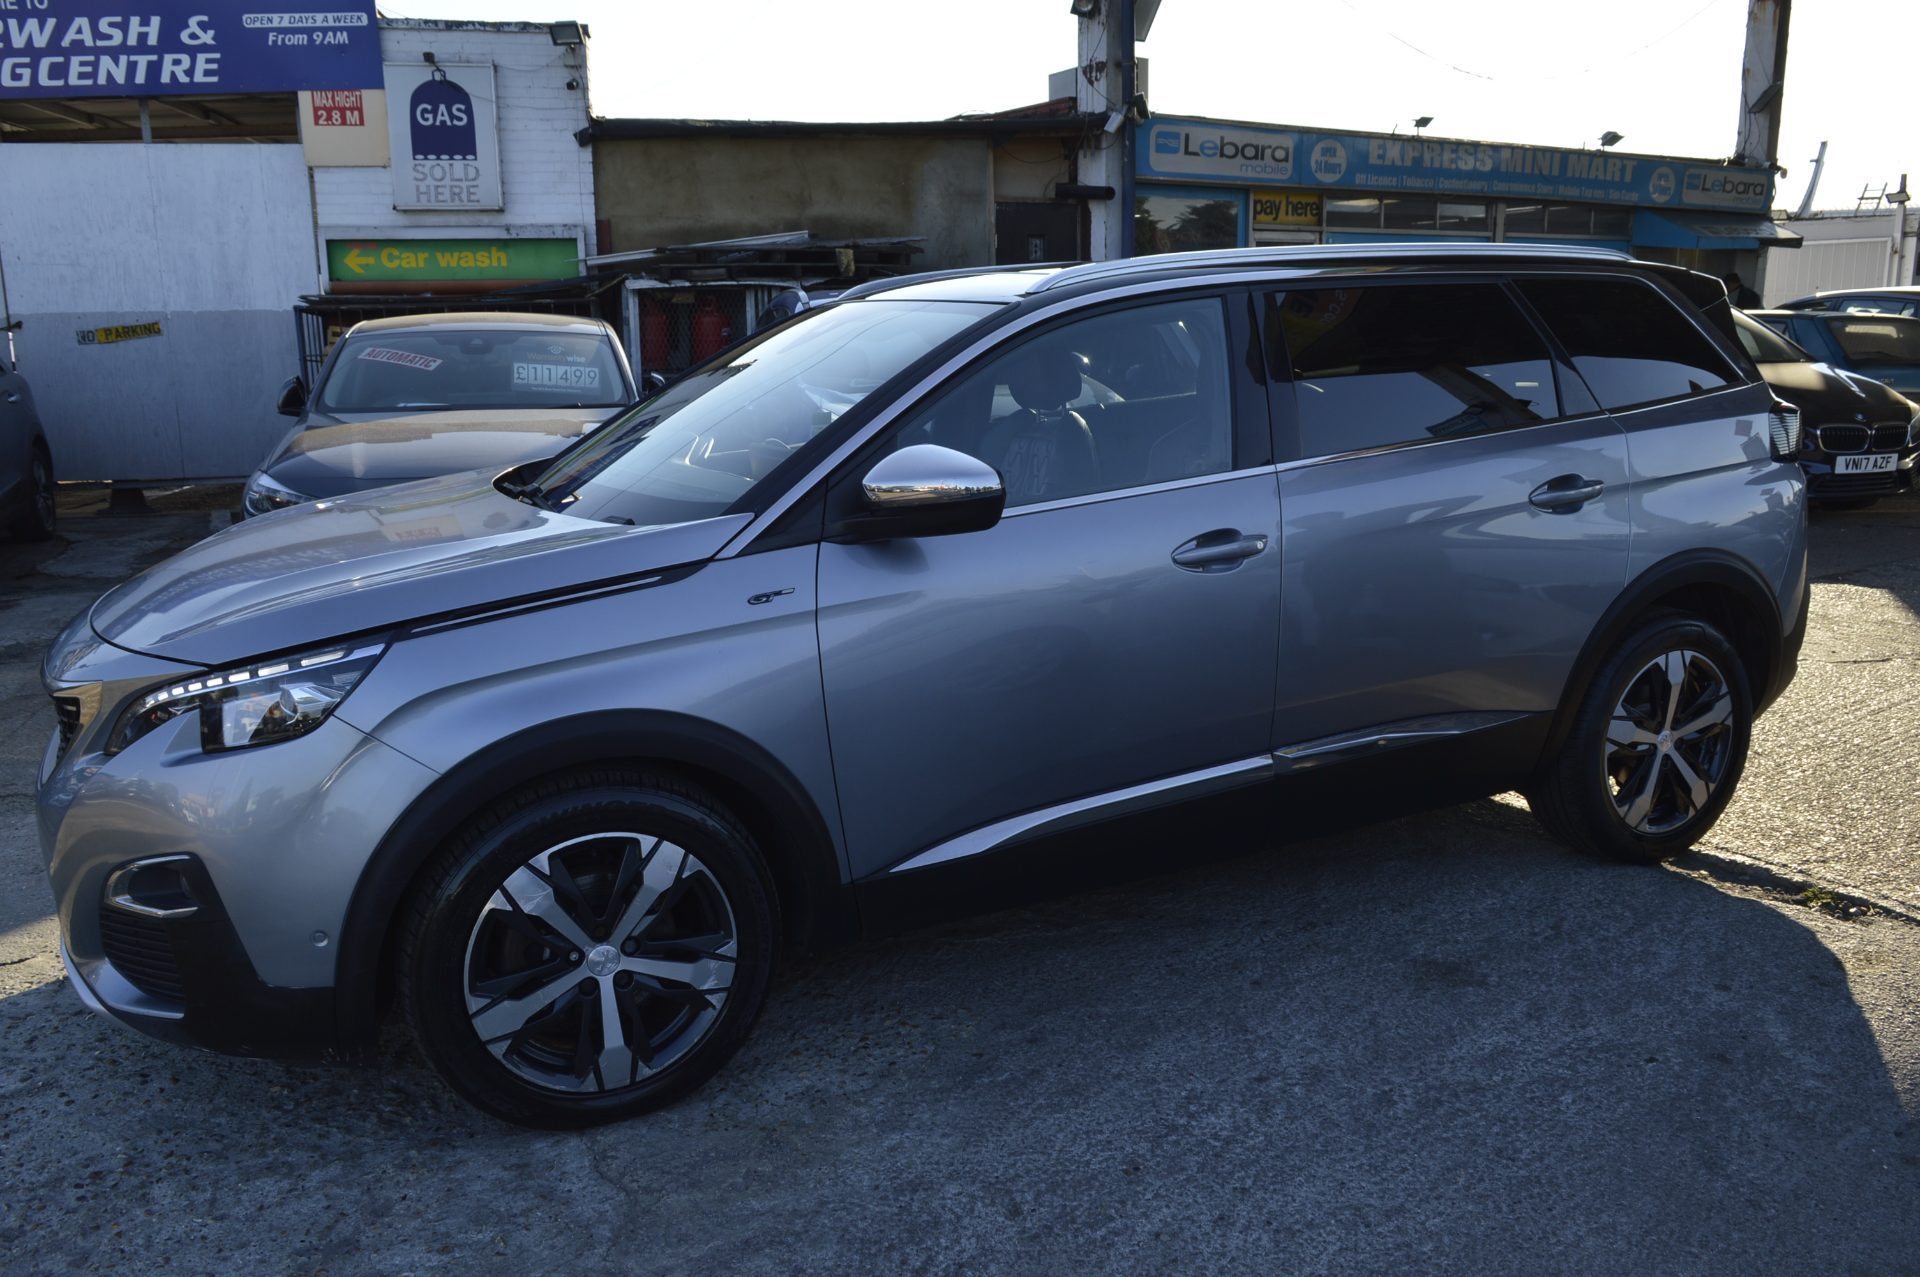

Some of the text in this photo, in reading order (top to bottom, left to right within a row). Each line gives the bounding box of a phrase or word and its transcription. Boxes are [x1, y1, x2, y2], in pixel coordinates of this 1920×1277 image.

[245, 14, 364, 26] OPEN 7 DAYS A WEEK
[0, 15, 216, 48] WASH &
[268, 31, 349, 46] From 9AM
[1, 53, 221, 87] GCENTRE
[314, 90, 362, 107] MAX HIGHT
[318, 110, 360, 126] 2.8 M
[416, 103, 468, 126] GAS
[1184, 133, 1290, 164] Lebara
[1240, 162, 1289, 176] mobile
[1368, 138, 1638, 182] EXPRESS MINI MART
[412, 163, 480, 183] SOLD
[416, 184, 481, 203] HERE
[1701, 174, 1765, 196] Lebara
[1253, 196, 1320, 220] pay here
[380, 247, 508, 268] Car wash
[104, 322, 161, 341] PARKING
[366, 348, 437, 369] AUTOMATIC
[516, 365, 598, 385] £11499
[1845, 456, 1892, 470] VN17 AZF
